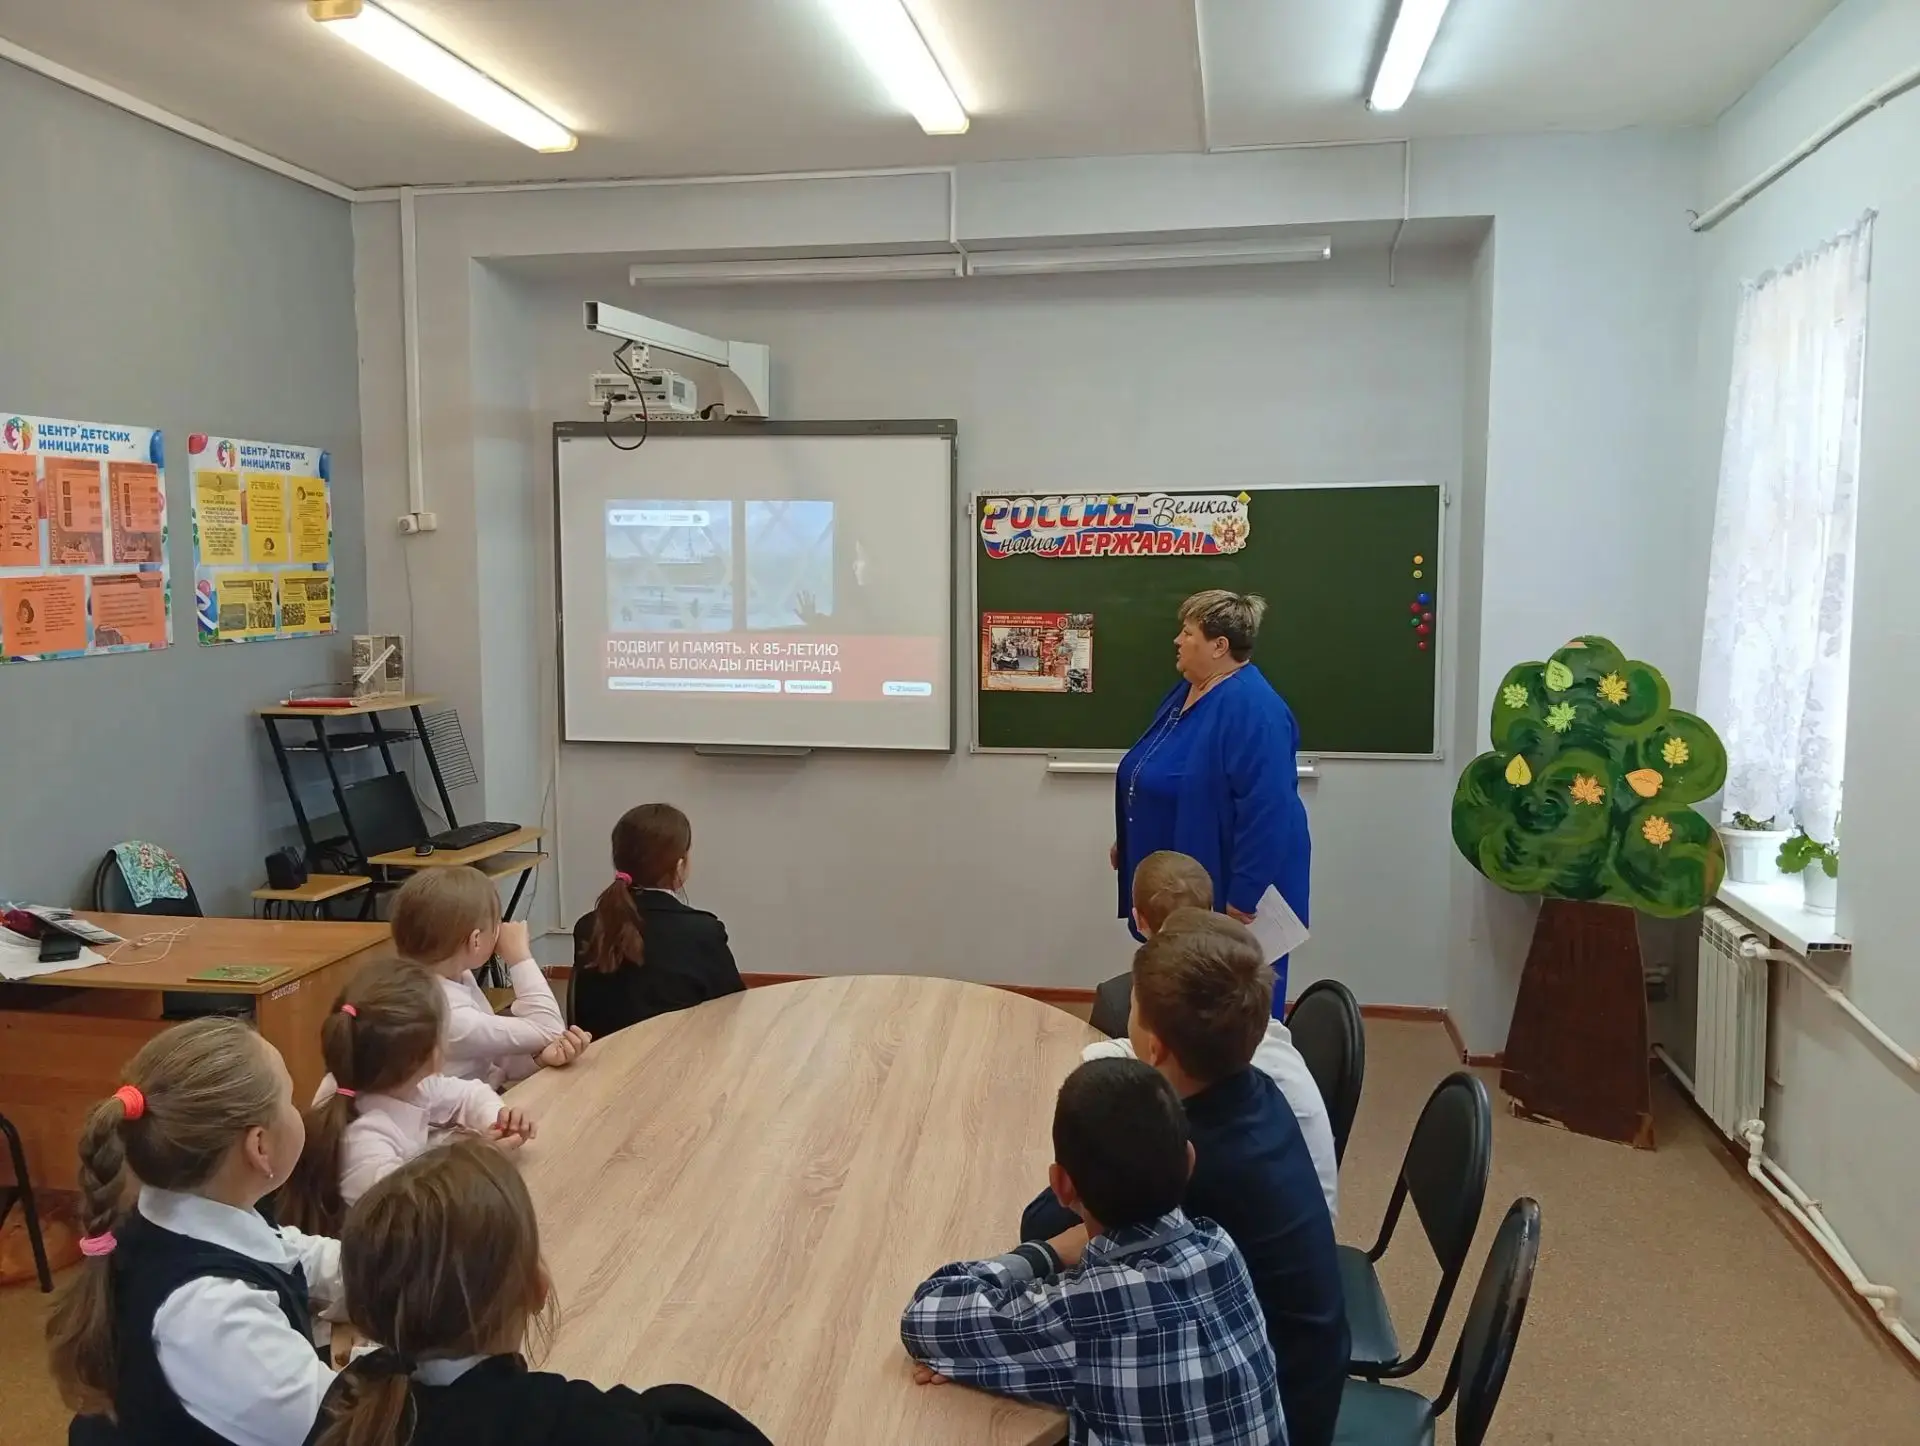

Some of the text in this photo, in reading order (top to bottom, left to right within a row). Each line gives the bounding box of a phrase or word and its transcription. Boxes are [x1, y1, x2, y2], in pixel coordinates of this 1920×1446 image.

[38, 423, 131, 443] ЦЕНТР ДЕТСКИХ
[38, 439, 110, 455] ИНИЦИАТИВ
[240, 445, 306, 461] ЦЕНТР ДЕТСКИХ
[240, 457, 291, 471] ИНИЦИАТИВ
[1152, 497, 1240, 527] Великая
[1000, 532, 1205, 555] наша ДЕРЖАВА!
[986, 615, 992, 624] 2
[606, 640, 839, 657] ПОДВИГ И ПАМЯТЬ. К 85-ЛЕТИЮ
[607, 657, 842, 675] НАЧАЛА БЛОКАДЫ ЛЕНИНГРАДА
